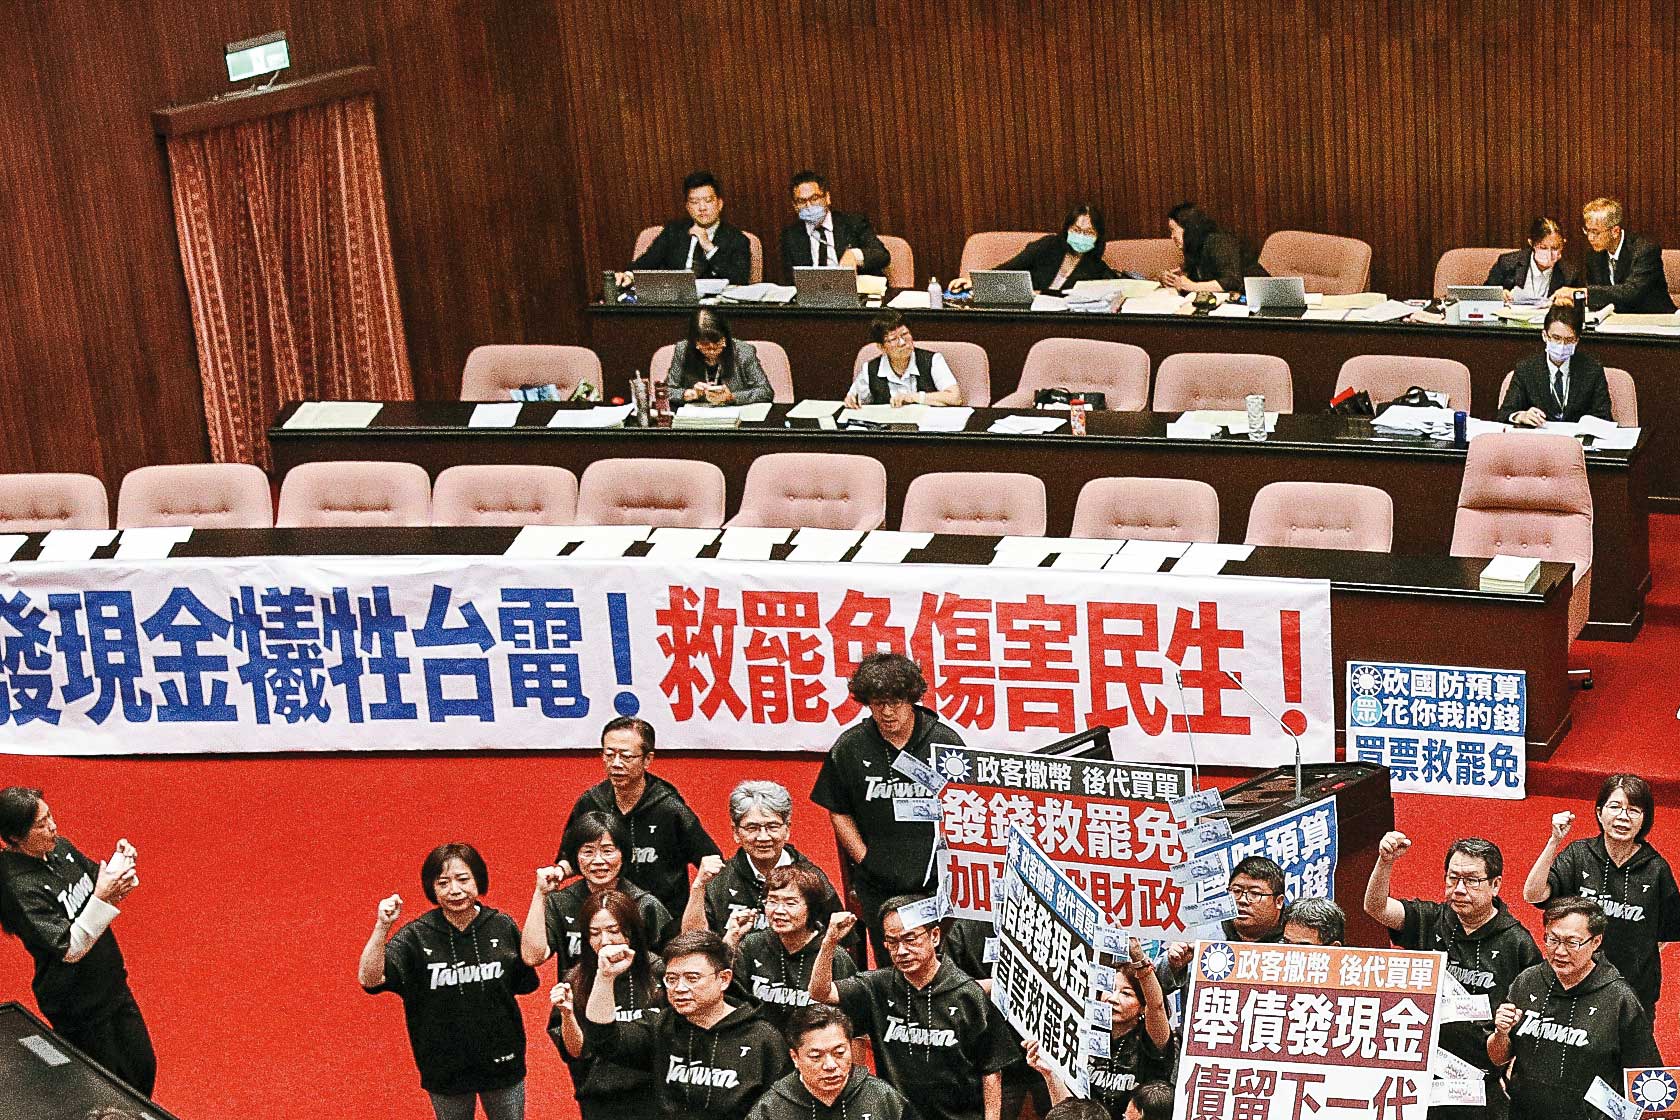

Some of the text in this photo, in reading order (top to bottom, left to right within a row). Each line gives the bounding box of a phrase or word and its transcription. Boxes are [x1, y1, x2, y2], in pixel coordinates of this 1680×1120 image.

[1382, 668, 1521, 703] 砍國防預算
[1382, 697, 1520, 733] 花你我的錢
[976, 756, 1180, 800] 政客撒幣 後代買單
[1356, 735, 1519, 788] 買票救罷免
[942, 790, 1182, 865] 發錢救罷免
[948, 855, 1186, 932] 加財政
[1057, 882, 1095, 944] 後代買單
[1238, 950, 1434, 990] 政客撒幣 後代買單
[1193, 985, 1429, 1062] 舉債發現金
